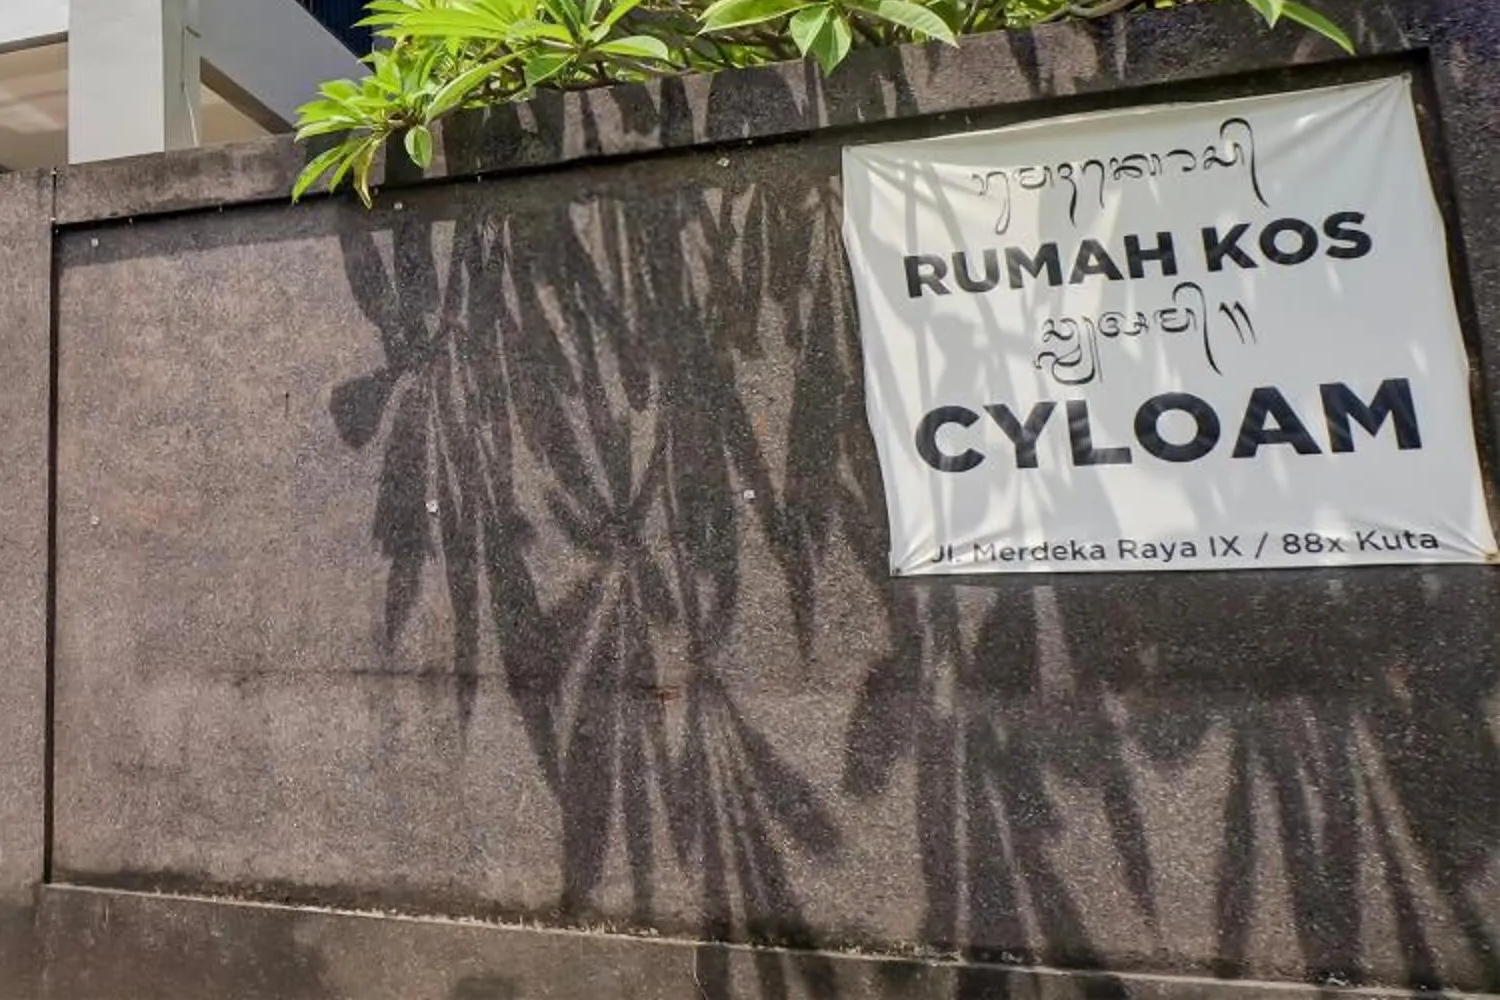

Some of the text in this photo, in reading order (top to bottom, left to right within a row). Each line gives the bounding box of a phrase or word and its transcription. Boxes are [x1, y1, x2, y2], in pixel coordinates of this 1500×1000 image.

[903, 211, 1375, 299] RUMAH KOS
[914, 377, 1423, 474] CYLOAM
[973, 540, 1107, 562] Merdeka
[1118, 538, 1197, 563] Raya
[1209, 535, 1243, 558] IX
[1255, 531, 1269, 560] /
[1282, 532, 1345, 555] 88x
[1356, 528, 1440, 552] Kuta
